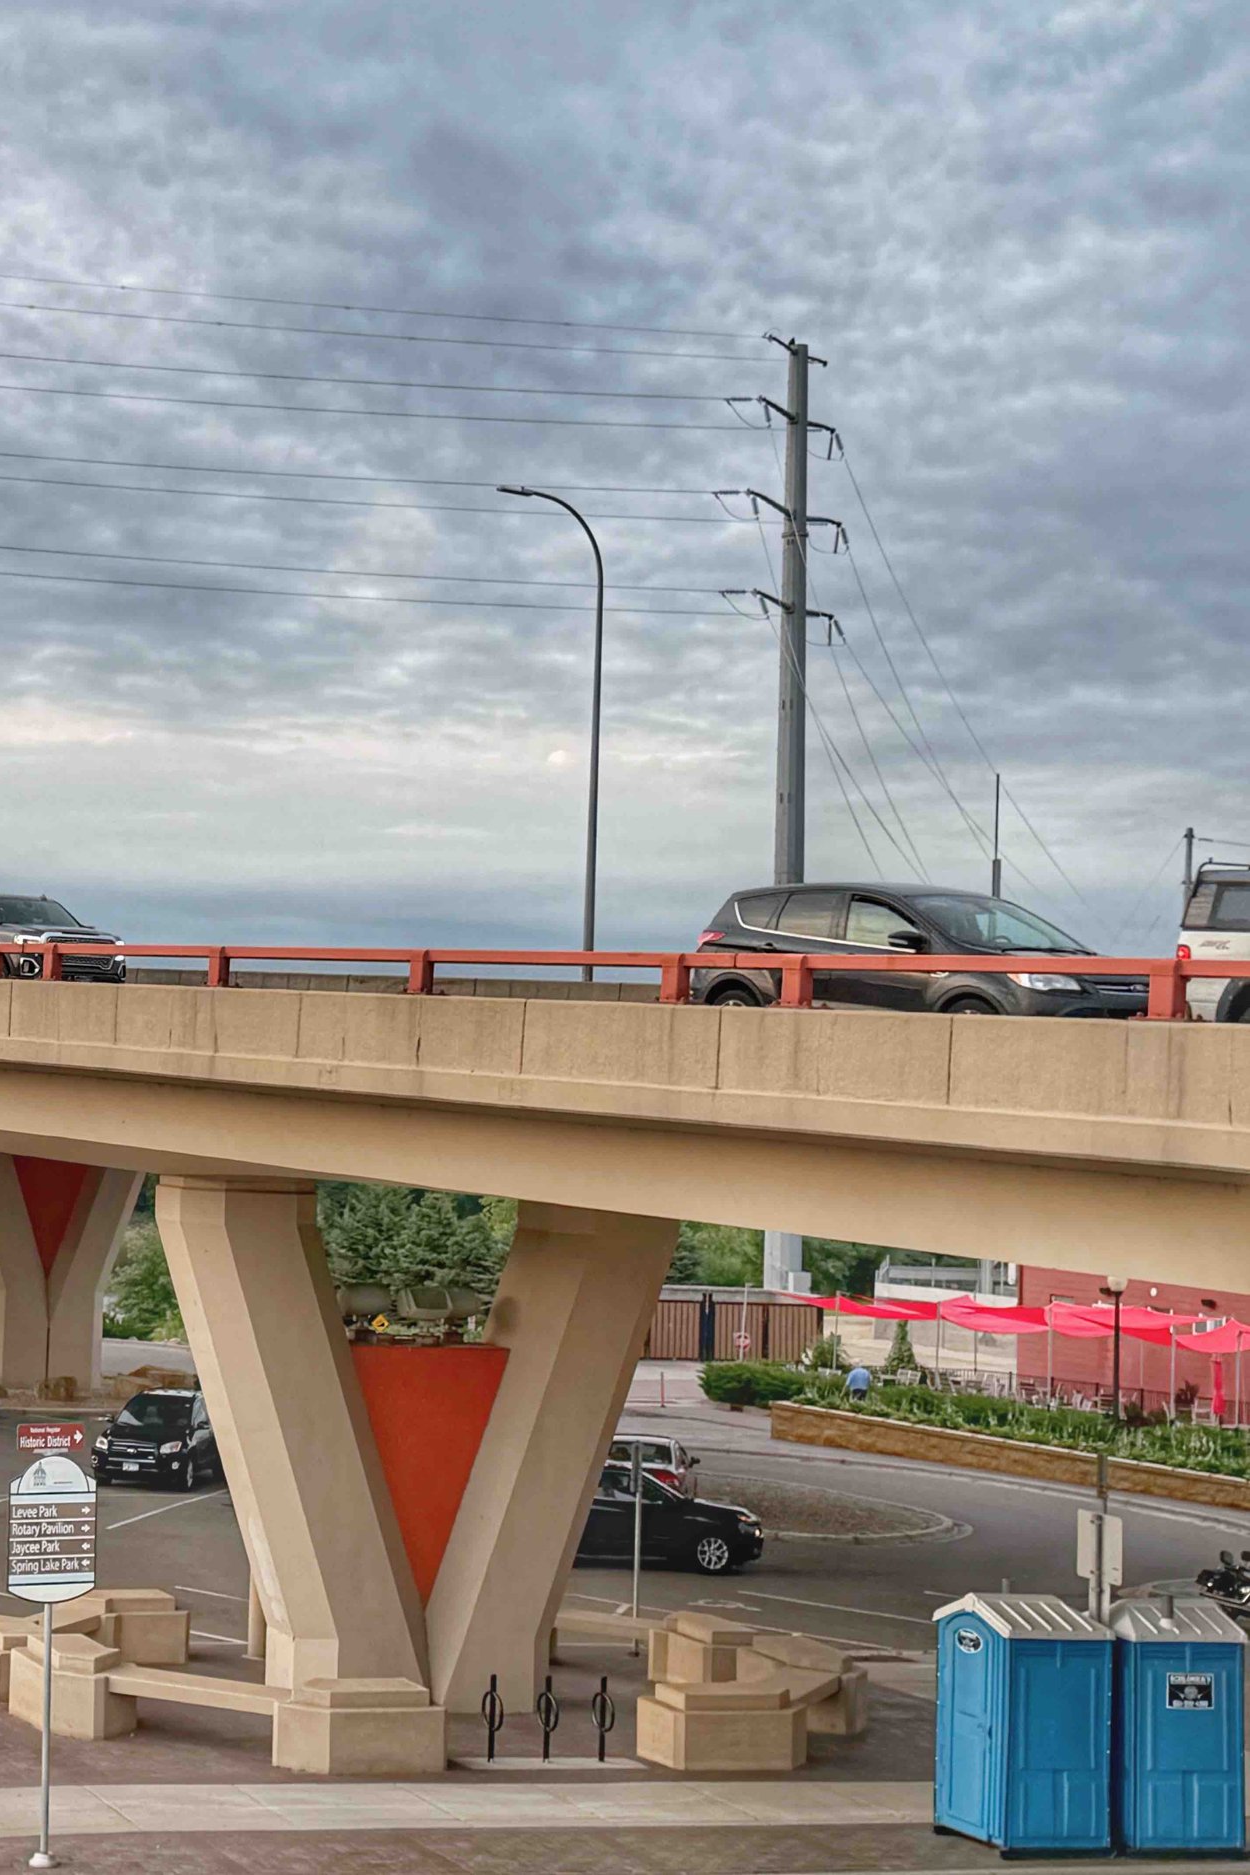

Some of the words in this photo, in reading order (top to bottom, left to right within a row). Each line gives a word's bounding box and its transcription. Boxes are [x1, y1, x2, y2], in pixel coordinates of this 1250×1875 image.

[20, 1436, 46, 1448] Historic
[47, 1435, 71, 1448] District
[12, 1505, 38, 1518] Levee
[39, 1504, 58, 1517] Park
[12, 1523, 40, 1538] Rotary
[41, 1522, 74, 1535] Pavilion
[11, 1542, 40, 1556] Jaycee
[41, 1541, 60, 1553] Park
[11, 1560, 40, 1574] Spring
[40, 1559, 60, 1571] Lake
[61, 1558, 80, 1571] Park
